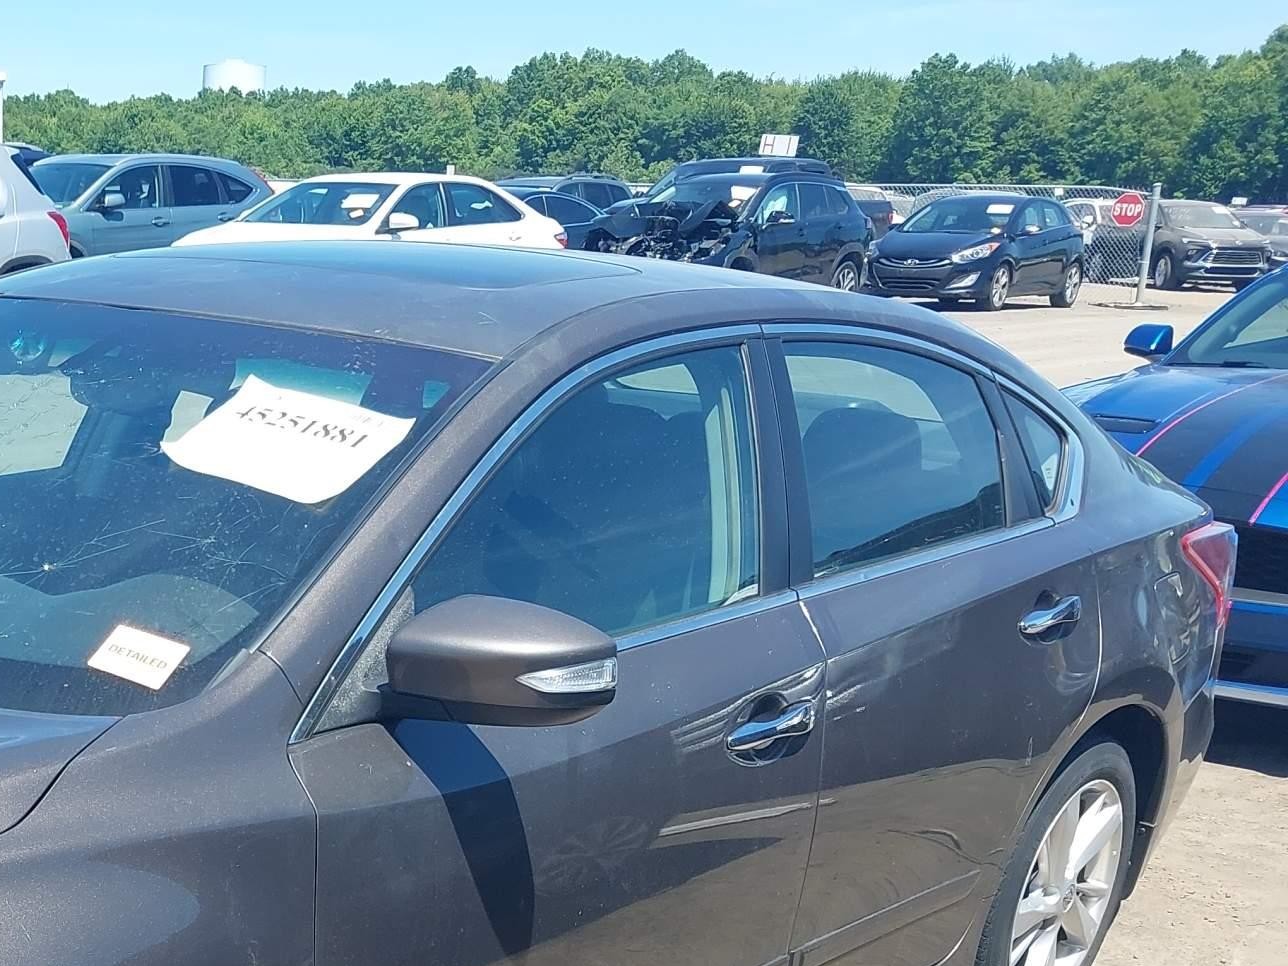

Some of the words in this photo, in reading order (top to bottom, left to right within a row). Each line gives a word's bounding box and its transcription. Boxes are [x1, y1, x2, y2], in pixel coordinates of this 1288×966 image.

[1113, 203, 1143, 217] STOP
[236, 406, 369, 448] 45251881
[108, 643, 168, 669] DETAILED
